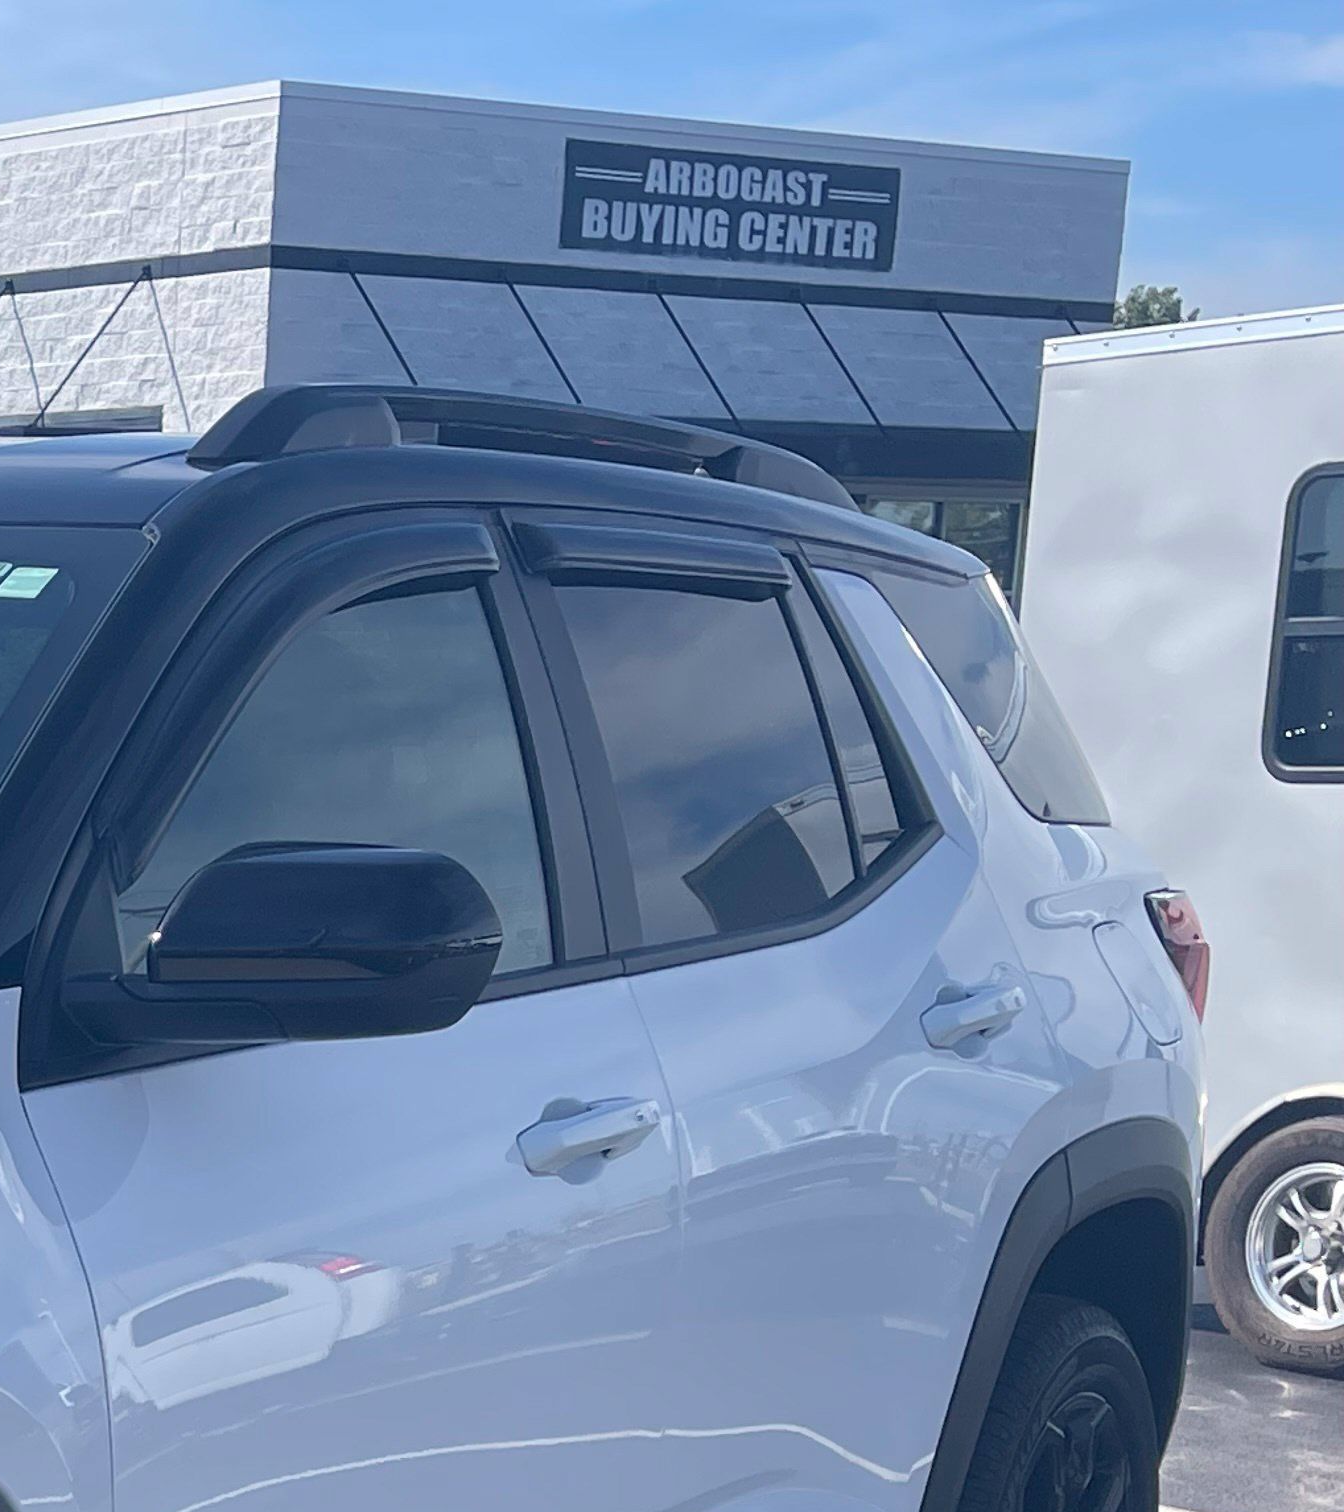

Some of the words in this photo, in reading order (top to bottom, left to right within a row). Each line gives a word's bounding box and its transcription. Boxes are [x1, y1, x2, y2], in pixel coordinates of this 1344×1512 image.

[644, 158, 828, 207] ARBOGAST
[582, 198, 729, 249] BUYING
[738, 210, 878, 260] CENTER
